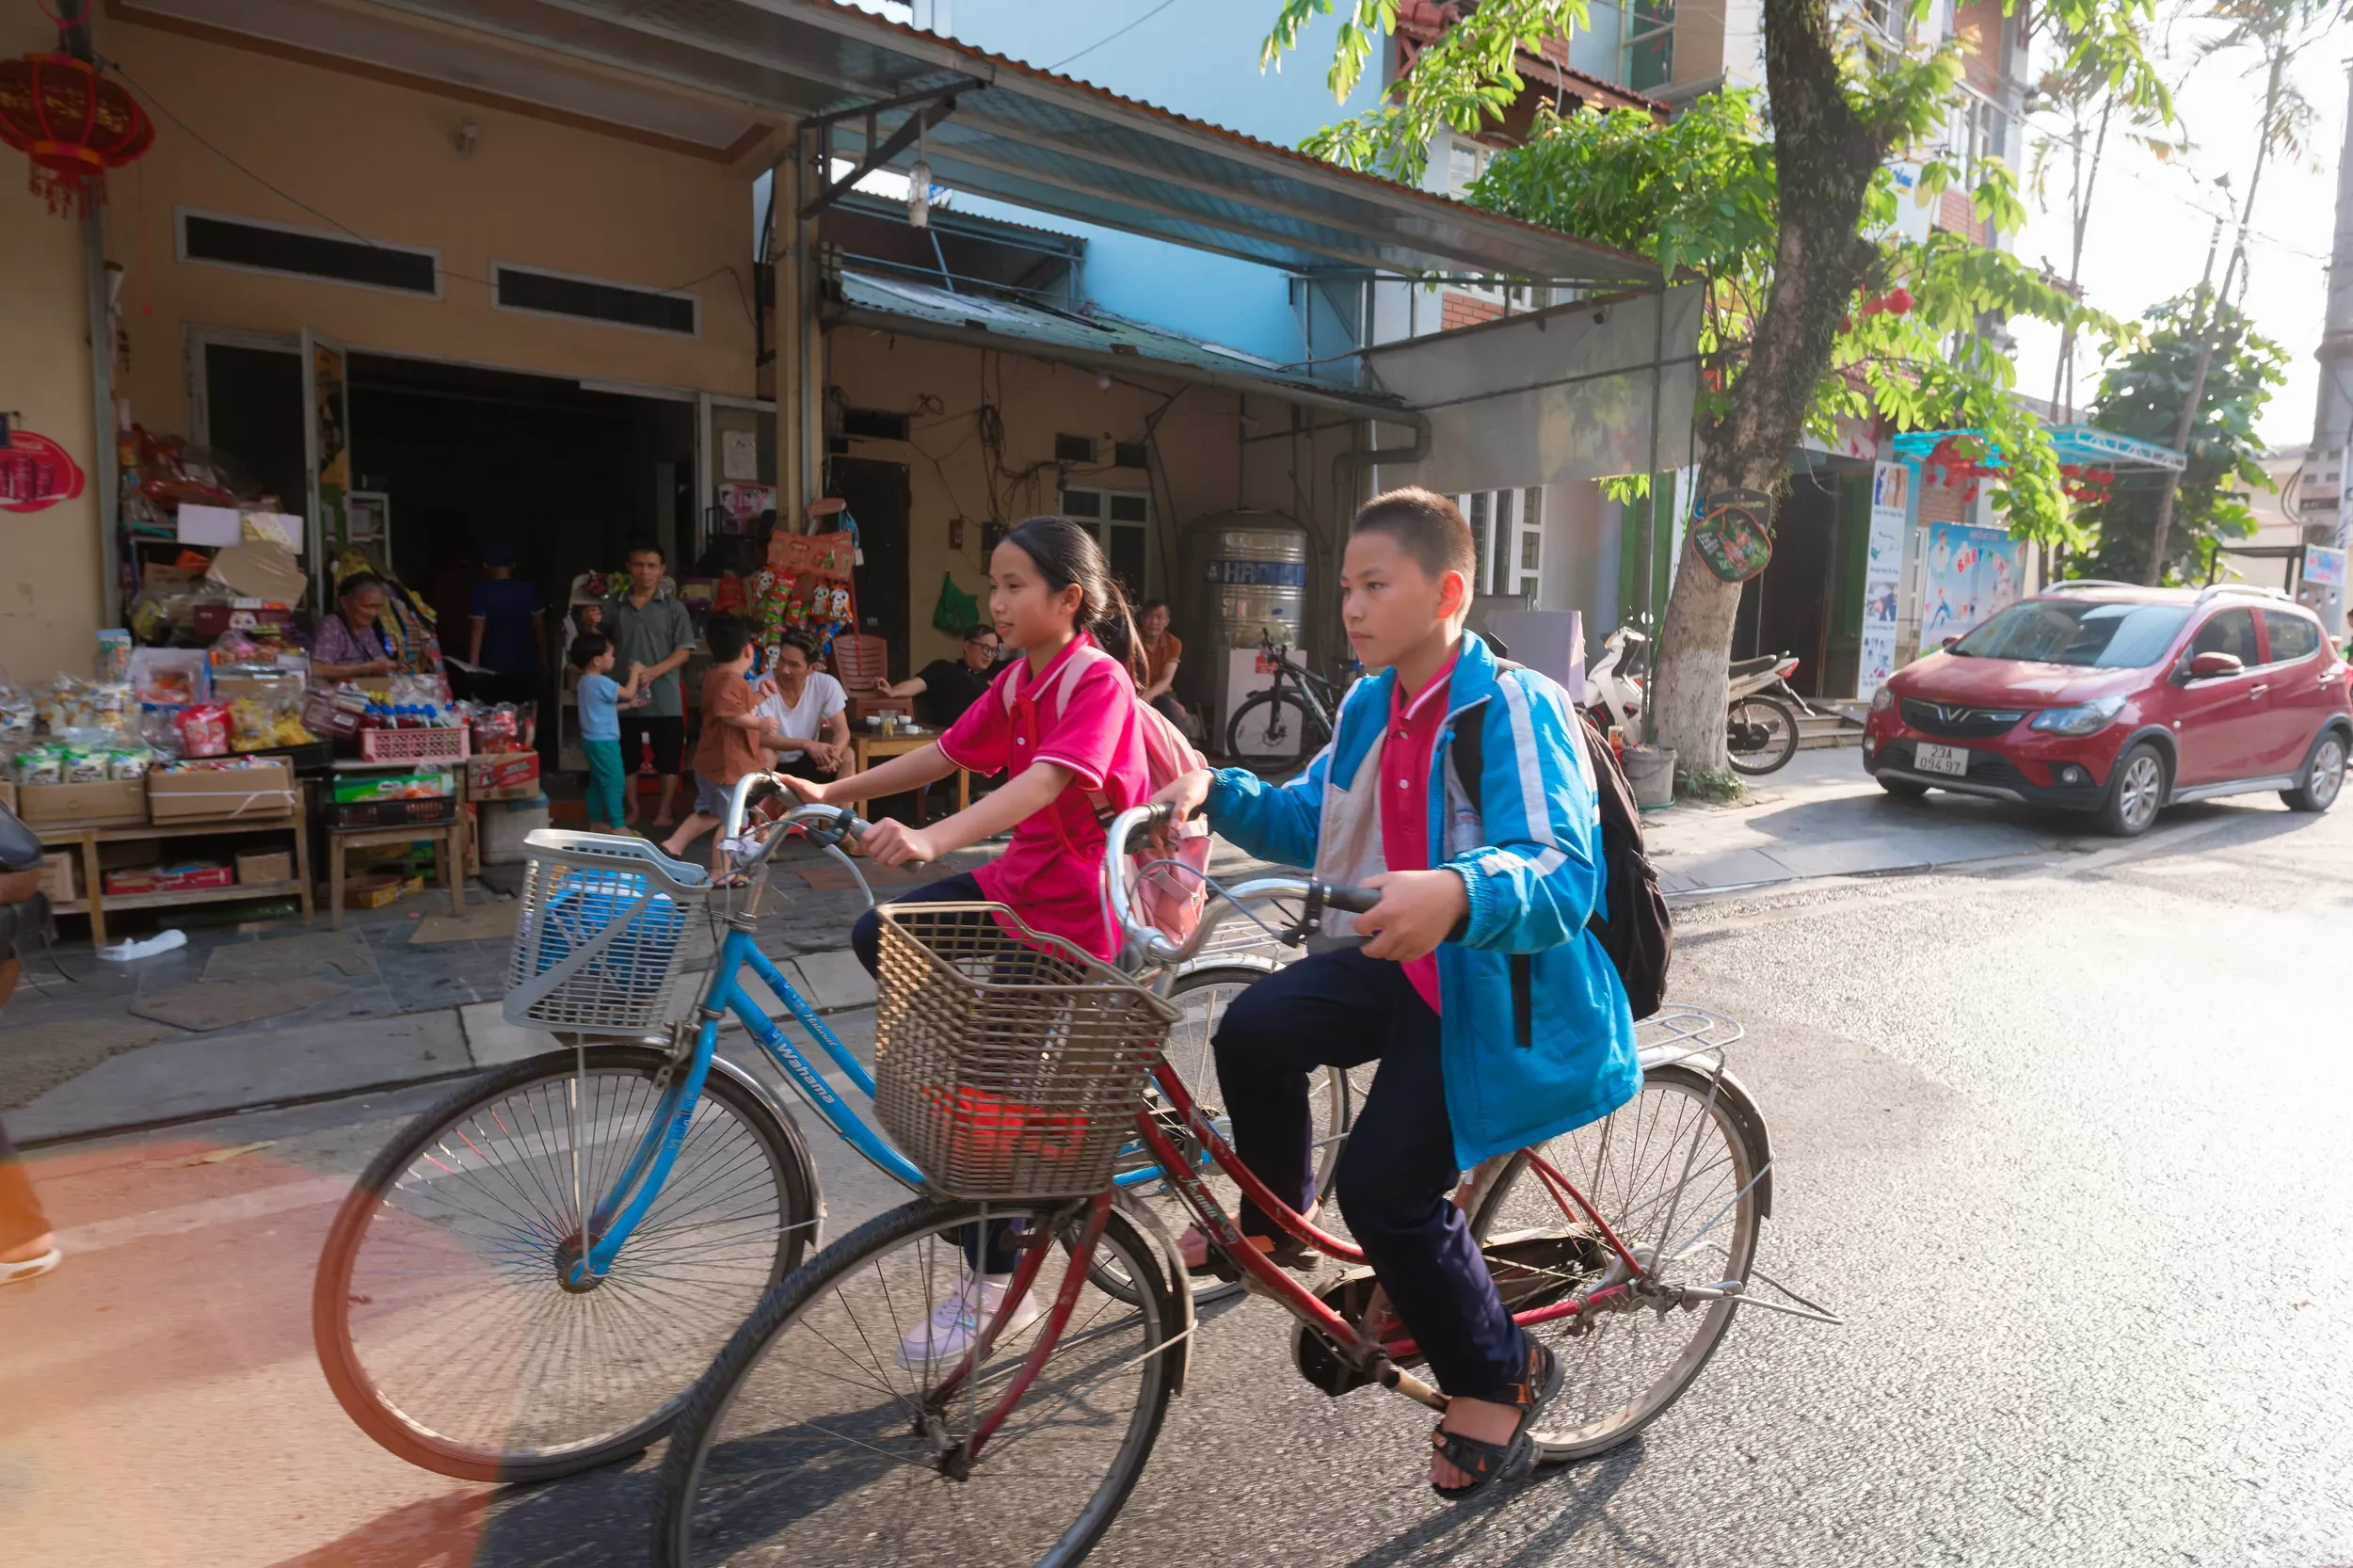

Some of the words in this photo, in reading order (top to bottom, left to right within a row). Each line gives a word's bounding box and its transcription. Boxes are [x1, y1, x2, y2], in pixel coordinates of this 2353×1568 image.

[1930, 745, 1952, 759] 23A
[1920, 757, 1961, 774] 094.97
[776, 1042, 836, 1104] Wahama
